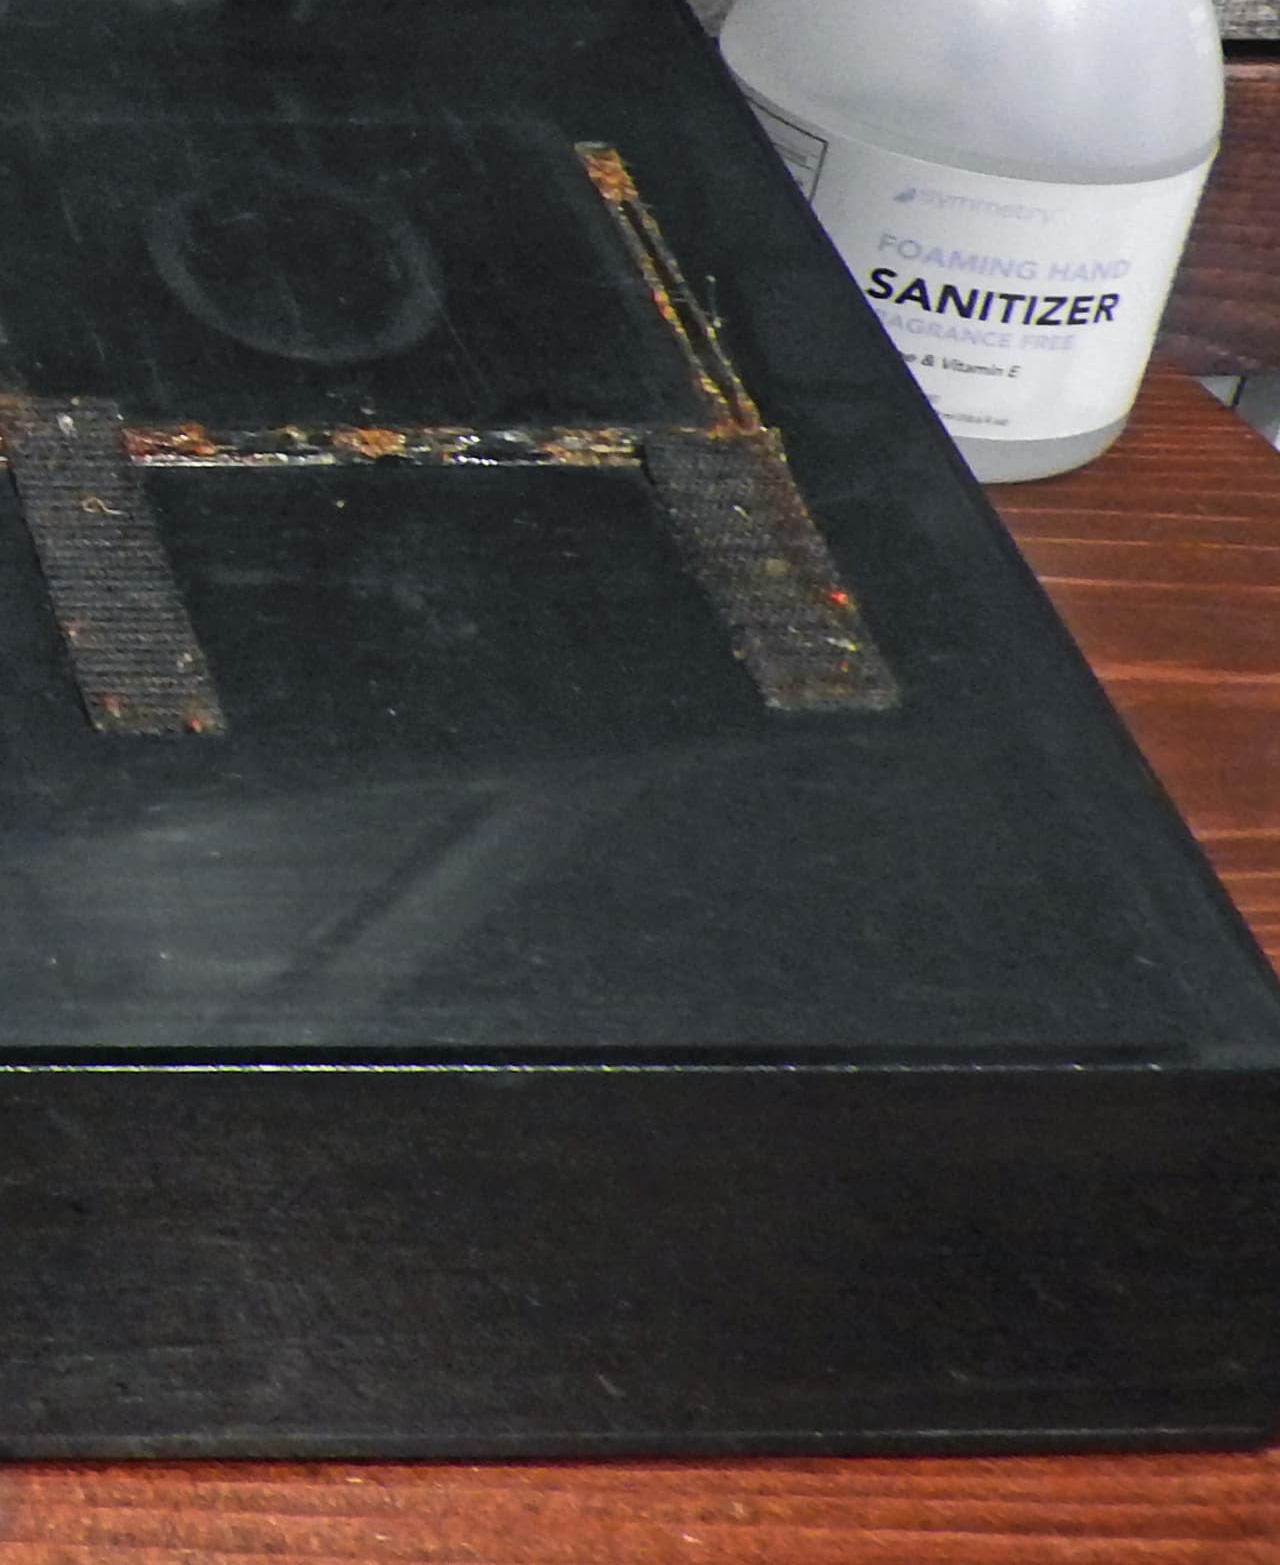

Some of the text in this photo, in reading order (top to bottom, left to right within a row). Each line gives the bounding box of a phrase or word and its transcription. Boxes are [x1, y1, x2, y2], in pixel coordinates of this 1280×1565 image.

[876, 234, 1131, 281] FOAMING HAND
[867, 268, 1120, 326] SANITIZER
